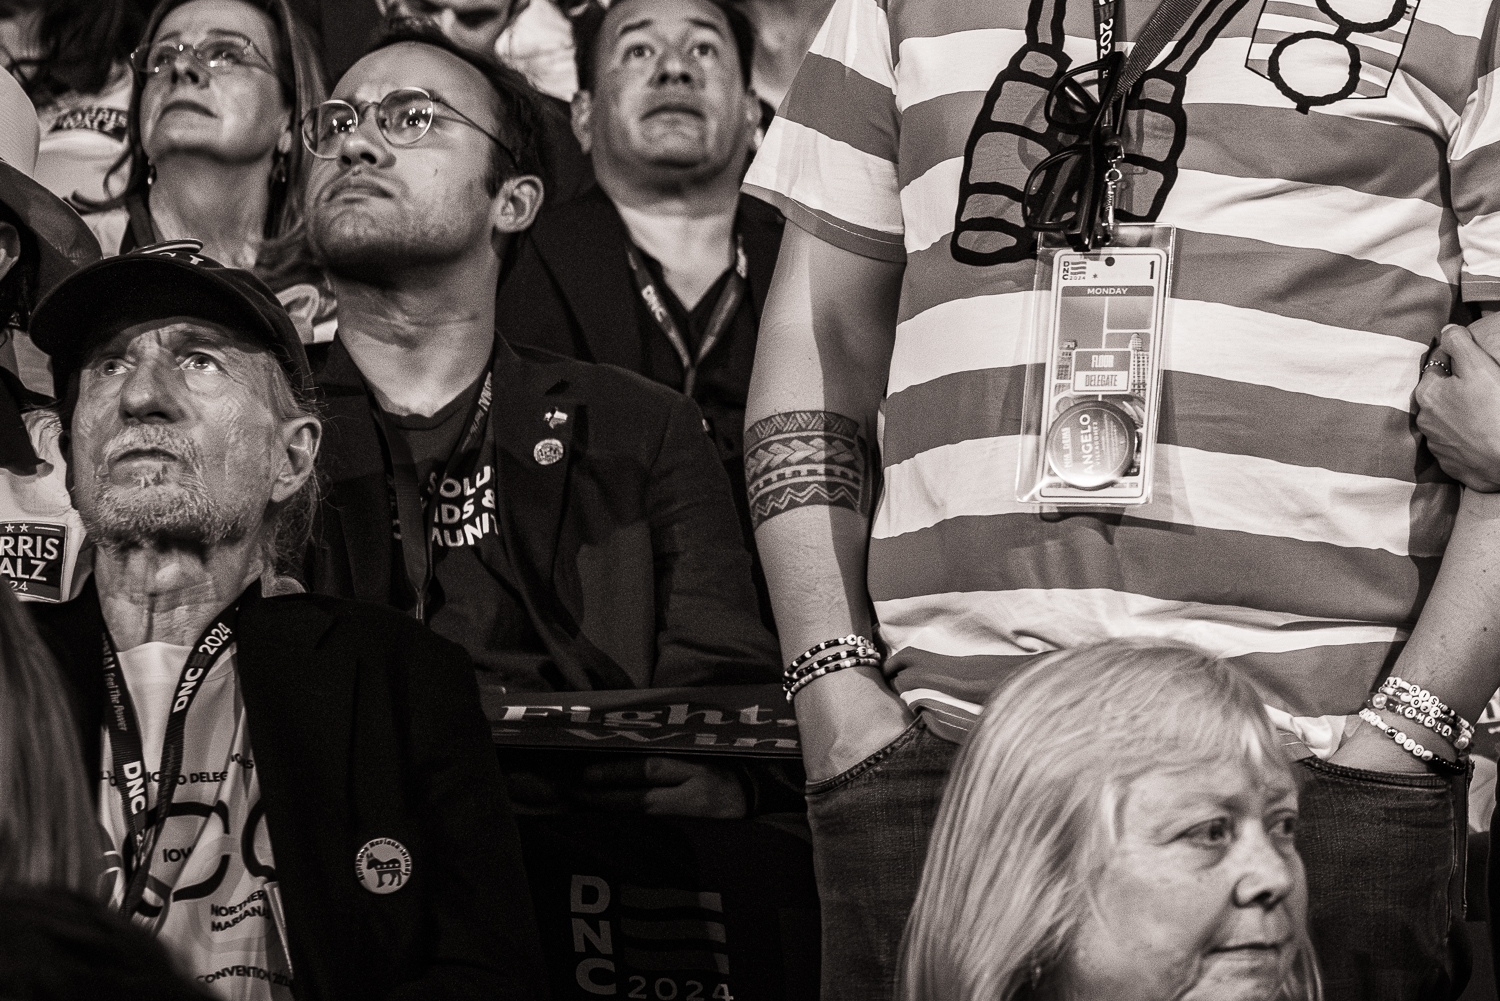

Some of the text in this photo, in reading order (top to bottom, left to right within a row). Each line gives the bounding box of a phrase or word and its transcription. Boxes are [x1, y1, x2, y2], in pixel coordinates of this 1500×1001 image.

[1099, 18, 1114, 60] 202
[1149, 260, 1155, 280] 1
[1086, 287, 1128, 295] MONDAY
[1091, 354, 1114, 368] FLOOR
[1085, 374, 1118, 387] DELEGATE
[1078, 413, 1095, 475] ANGELO
[172, 622, 233, 714] DNC 2024
[1395, 704, 1453, 737] KAMALA
[123, 760, 147, 815] DNC
[188, 771, 229, 784] DELEG
[162, 847, 195, 864] IOW
[210, 889, 265, 917] NORTHER
[569, 873, 618, 996] DNC
[627, 974, 736, 1001] 2024
